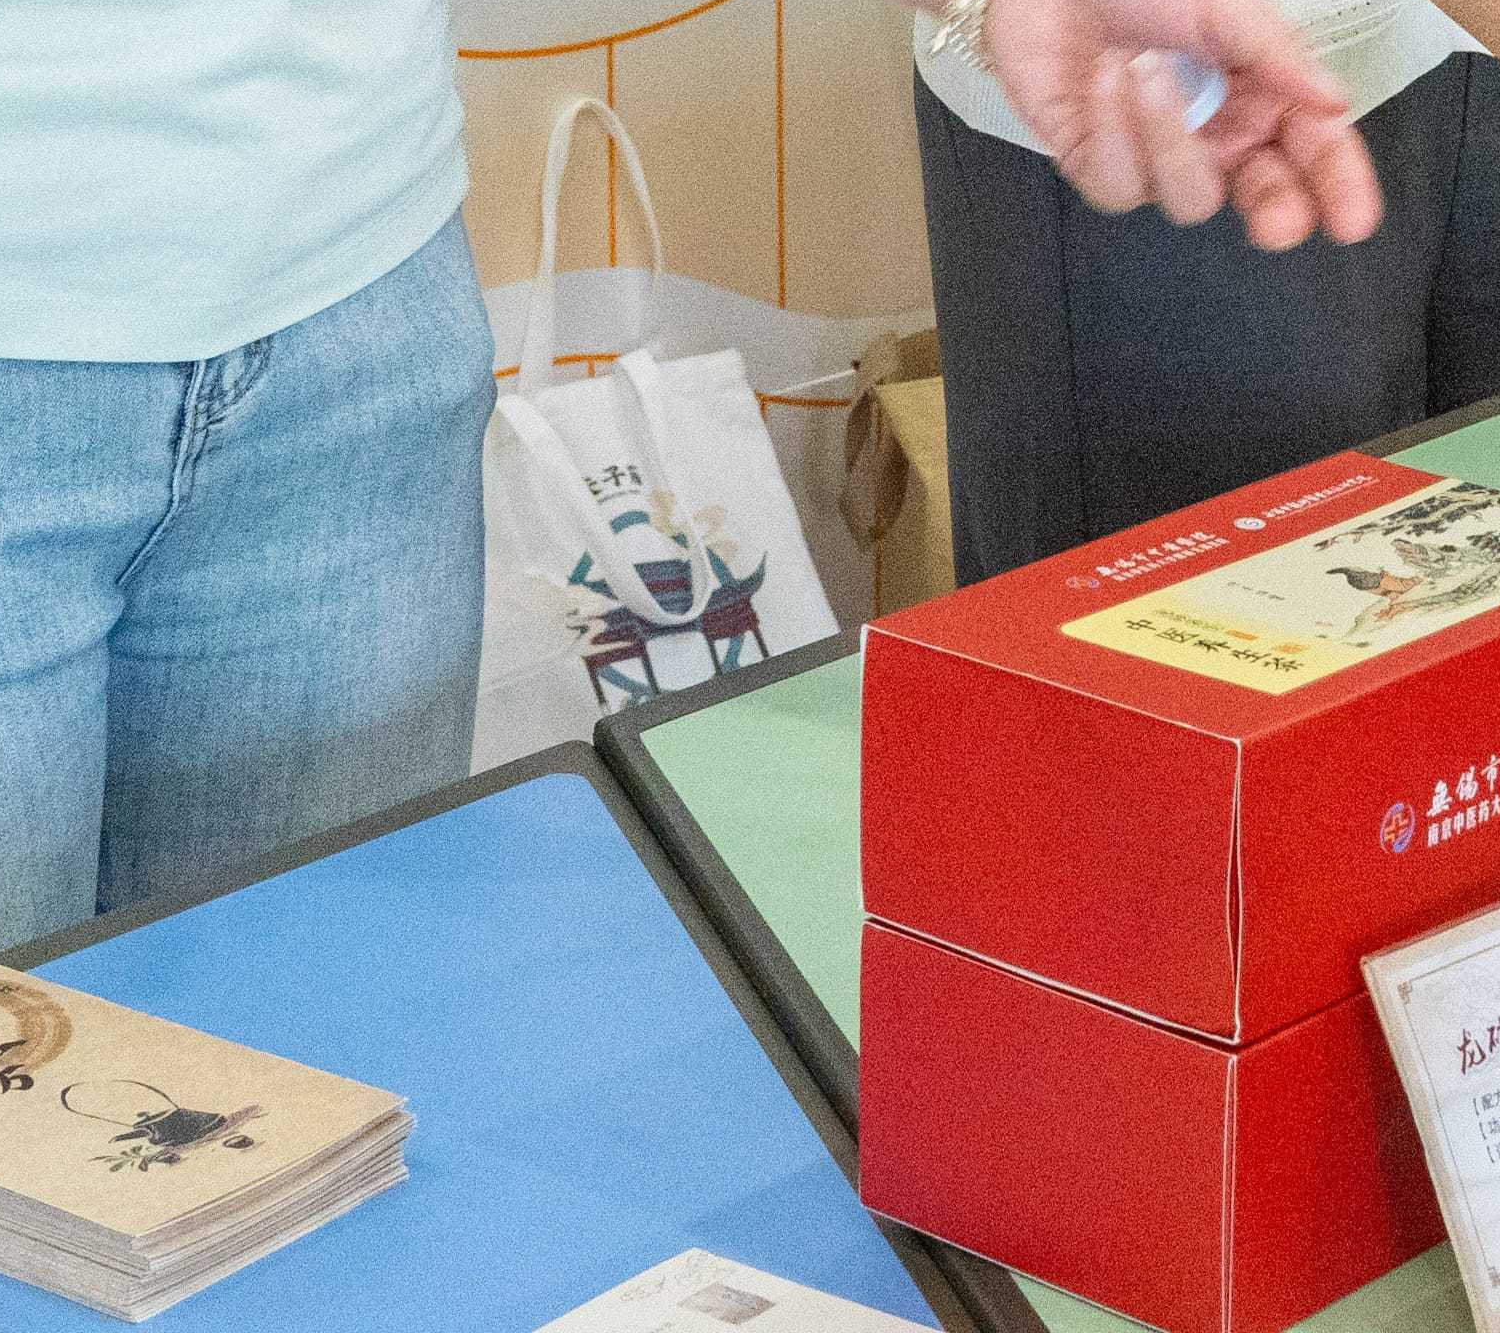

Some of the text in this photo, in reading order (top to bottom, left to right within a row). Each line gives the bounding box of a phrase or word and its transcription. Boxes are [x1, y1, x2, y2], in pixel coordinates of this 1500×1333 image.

[1124, 618, 1304, 672] 中医养生茶
